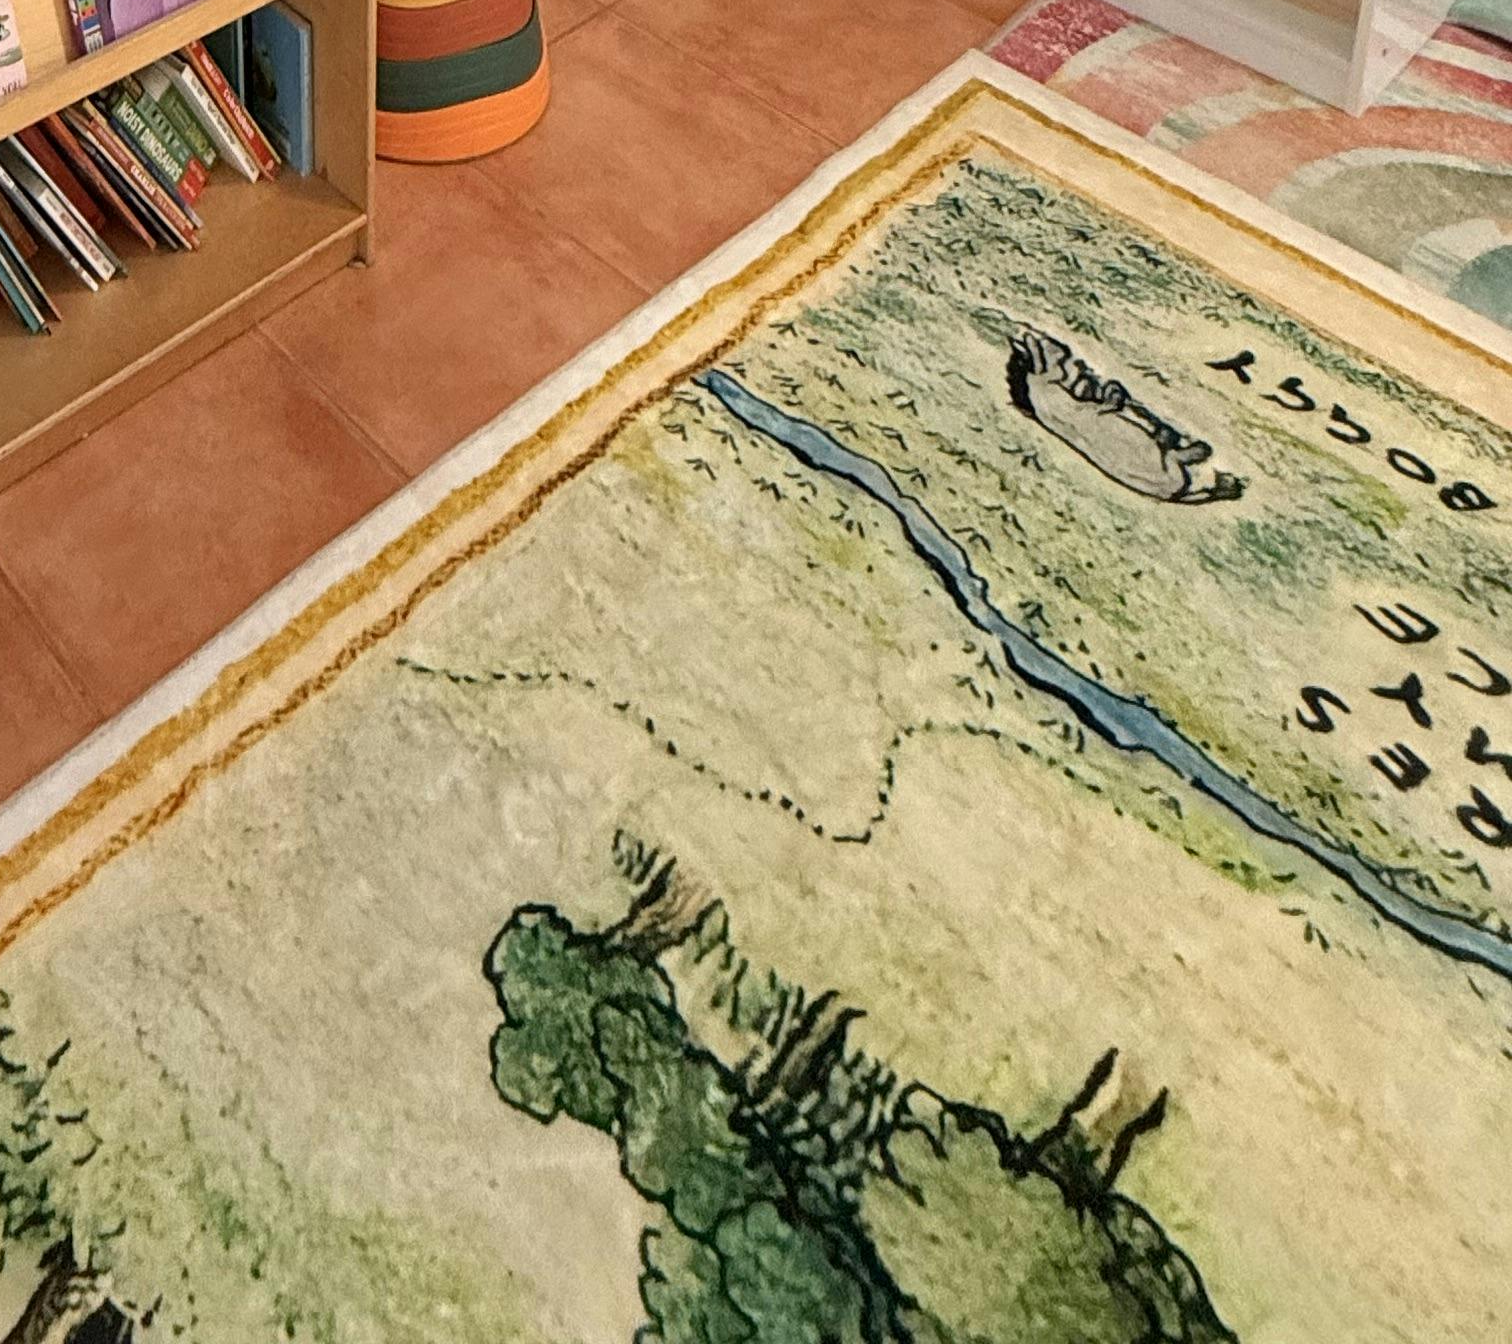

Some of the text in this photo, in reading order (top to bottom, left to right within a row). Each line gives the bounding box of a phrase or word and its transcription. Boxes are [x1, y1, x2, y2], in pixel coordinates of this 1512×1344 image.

[113, 99, 147, 136] NOISY
[136, 126, 186, 183] DINOSAURS
[1204, 348, 1500, 512] BOGGY
